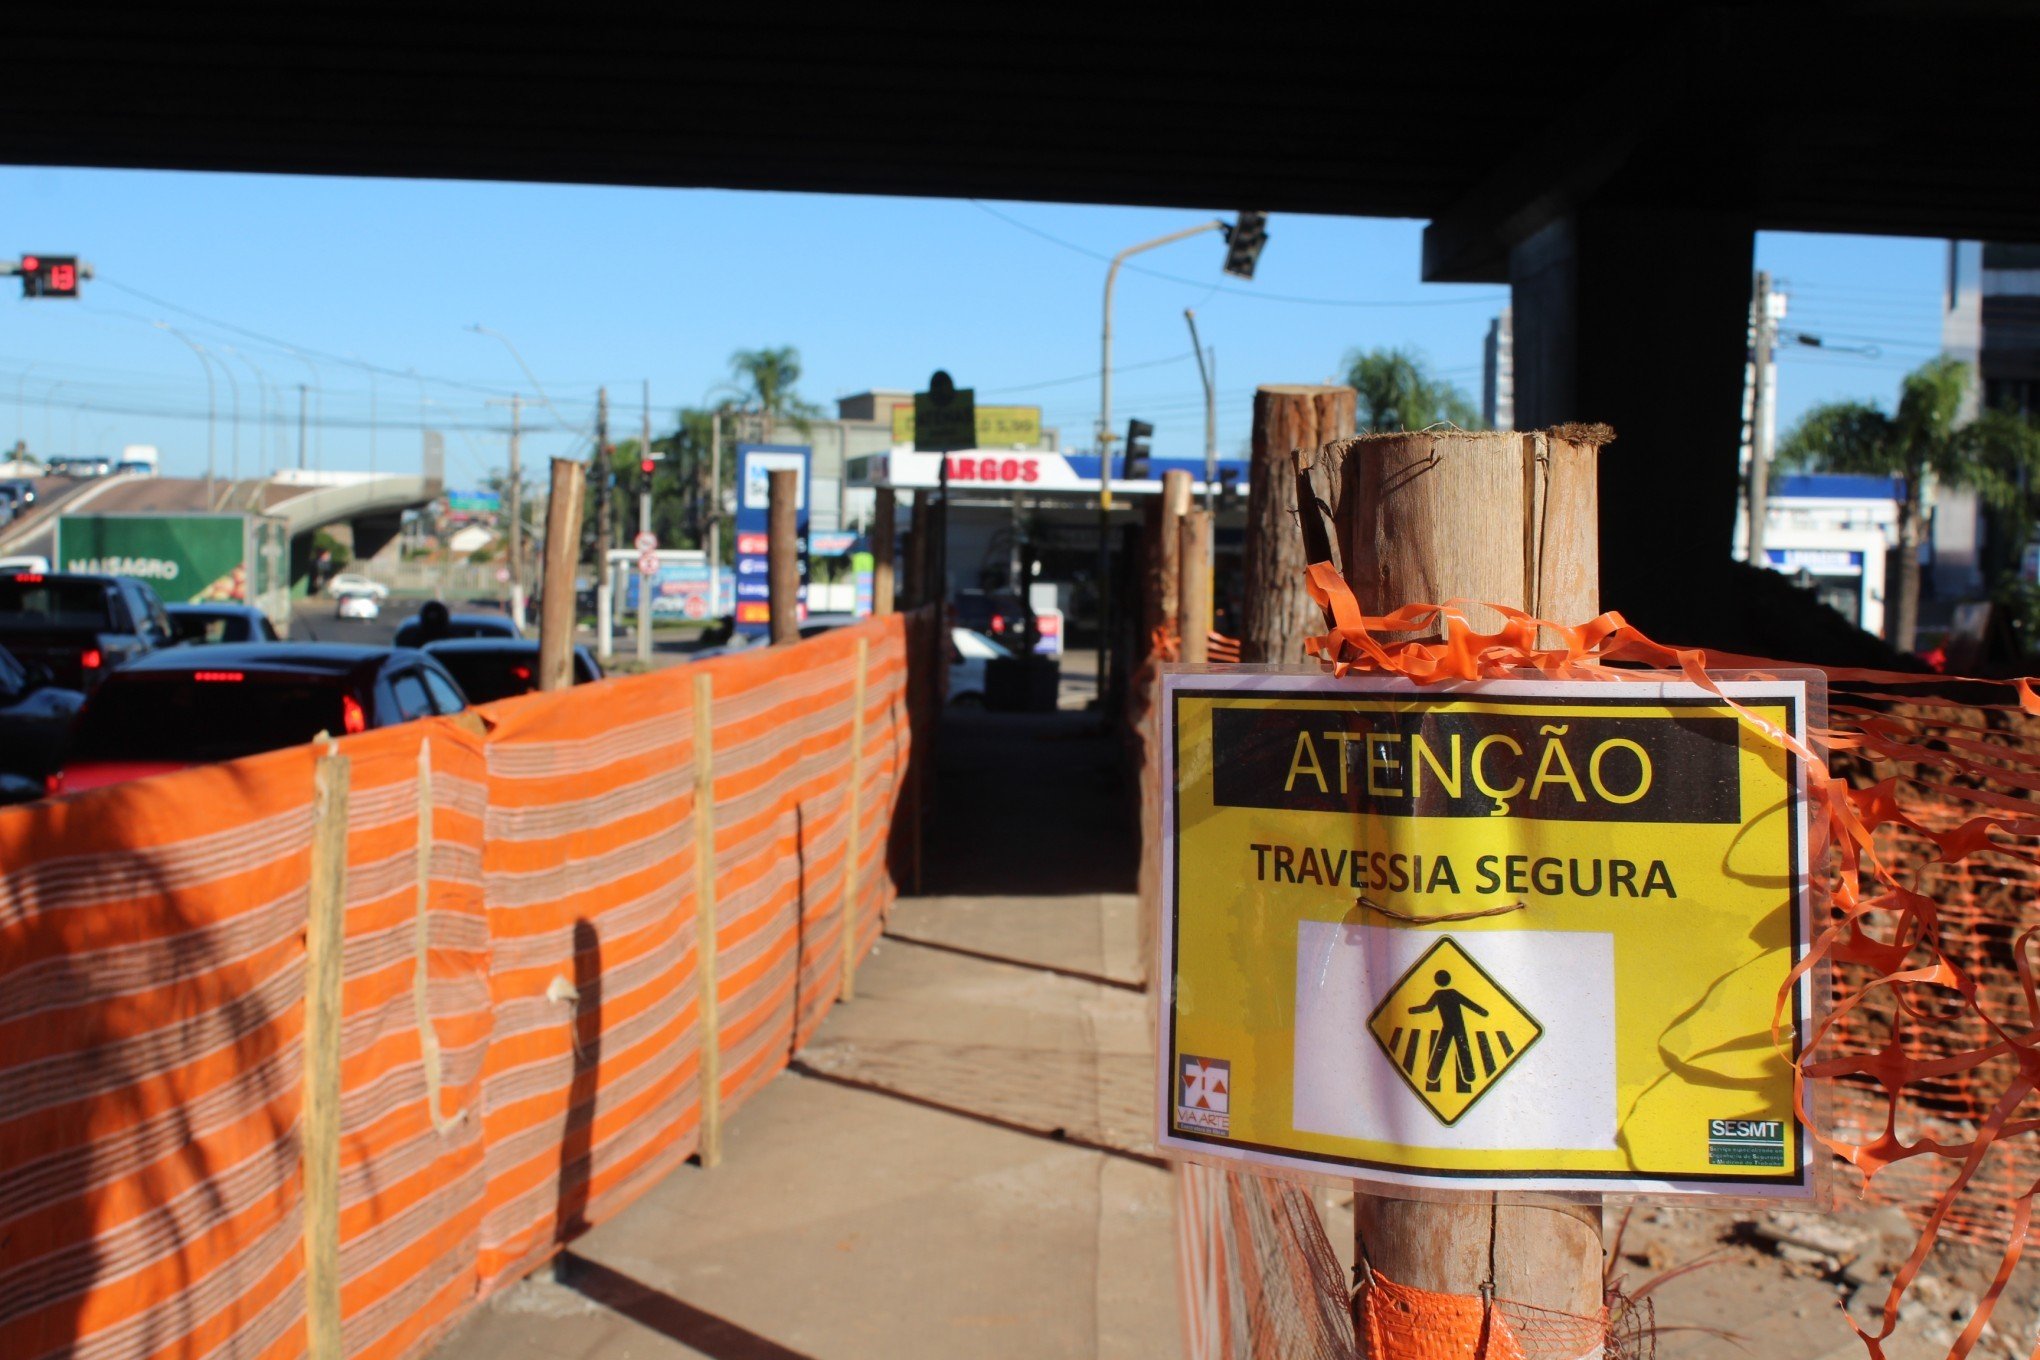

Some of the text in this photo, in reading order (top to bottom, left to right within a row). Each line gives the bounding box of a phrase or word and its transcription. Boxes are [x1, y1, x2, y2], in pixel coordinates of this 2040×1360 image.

[51, 264, 75, 291] 13
[1284, 724, 1652, 816] ATENÇÃO
[1250, 843, 1677, 899] TRAVESSIA SEGURA
[1177, 1108, 1230, 1128] VIA ARTE
[1712, 1120, 1779, 1138] SESMT
